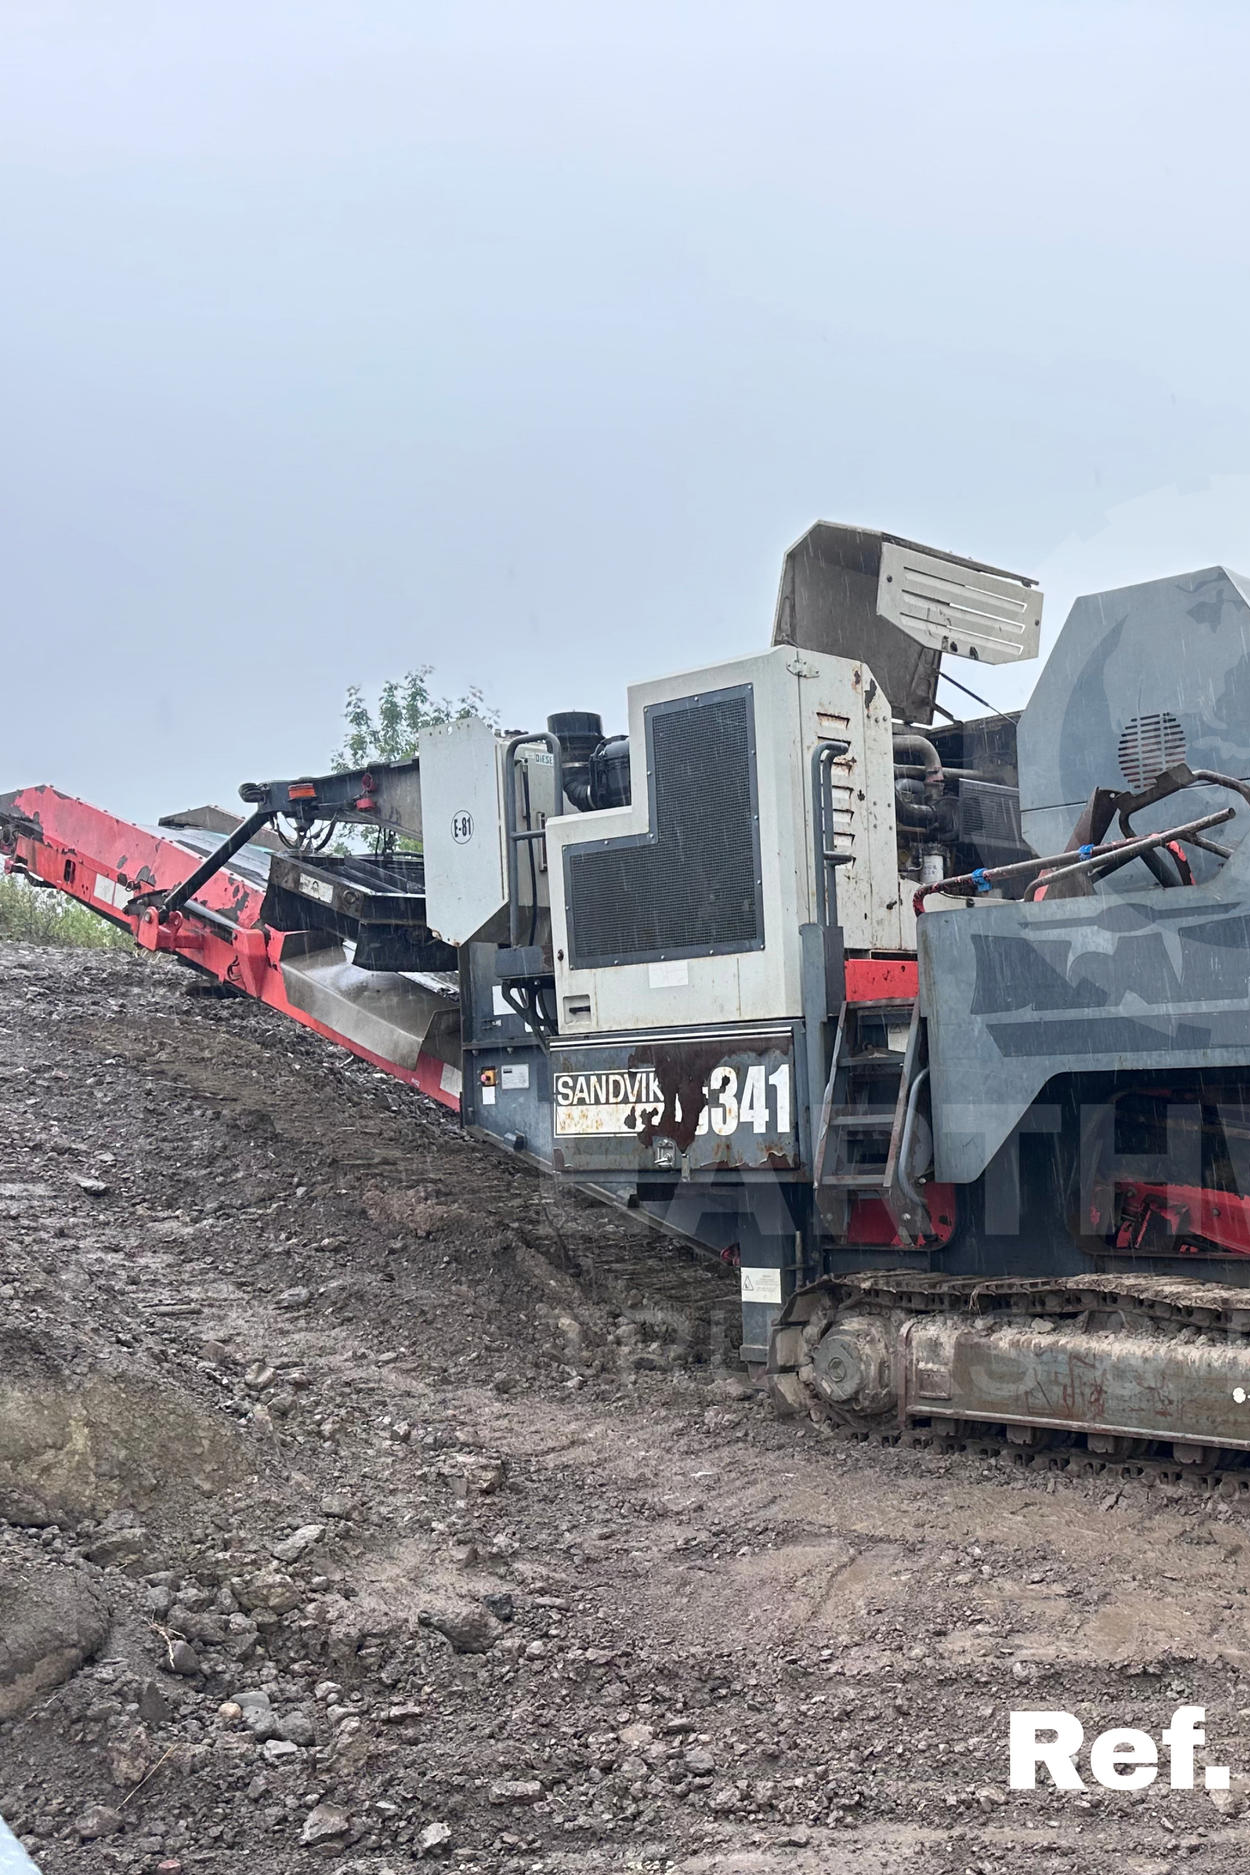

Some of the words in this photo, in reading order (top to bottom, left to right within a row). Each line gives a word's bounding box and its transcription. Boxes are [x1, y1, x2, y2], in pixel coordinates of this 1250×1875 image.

[535, 754, 553, 765] DIESE
[454, 816, 471, 838] E-81
[556, 1072, 666, 1106] SANDVIK
